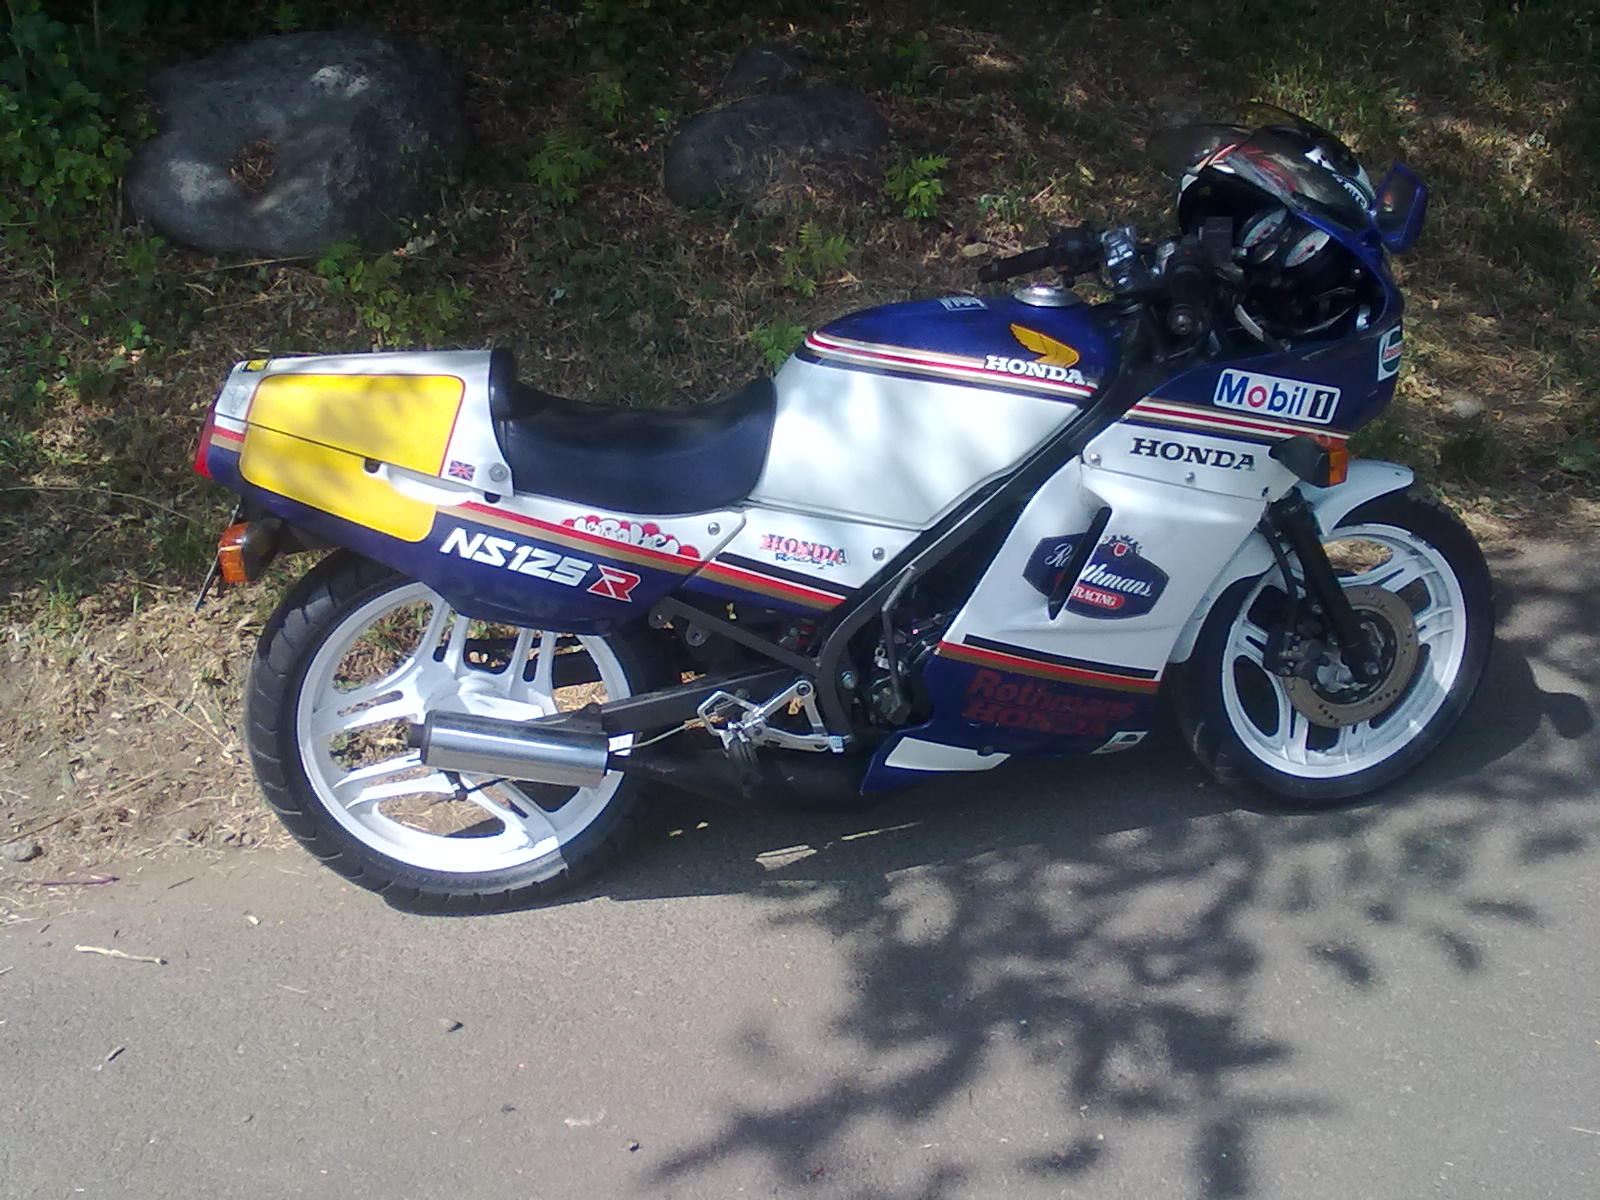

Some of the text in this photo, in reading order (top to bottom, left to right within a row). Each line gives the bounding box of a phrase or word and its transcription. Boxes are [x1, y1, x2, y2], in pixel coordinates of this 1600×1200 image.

[984, 355, 1087, 385] HONDA
[1217, 373, 1332, 419] Mobil 1
[1130, 437, 1255, 472] HONDA
[760, 533, 847, 564] HONDA
[1044, 543, 1153, 597] Rthmans
